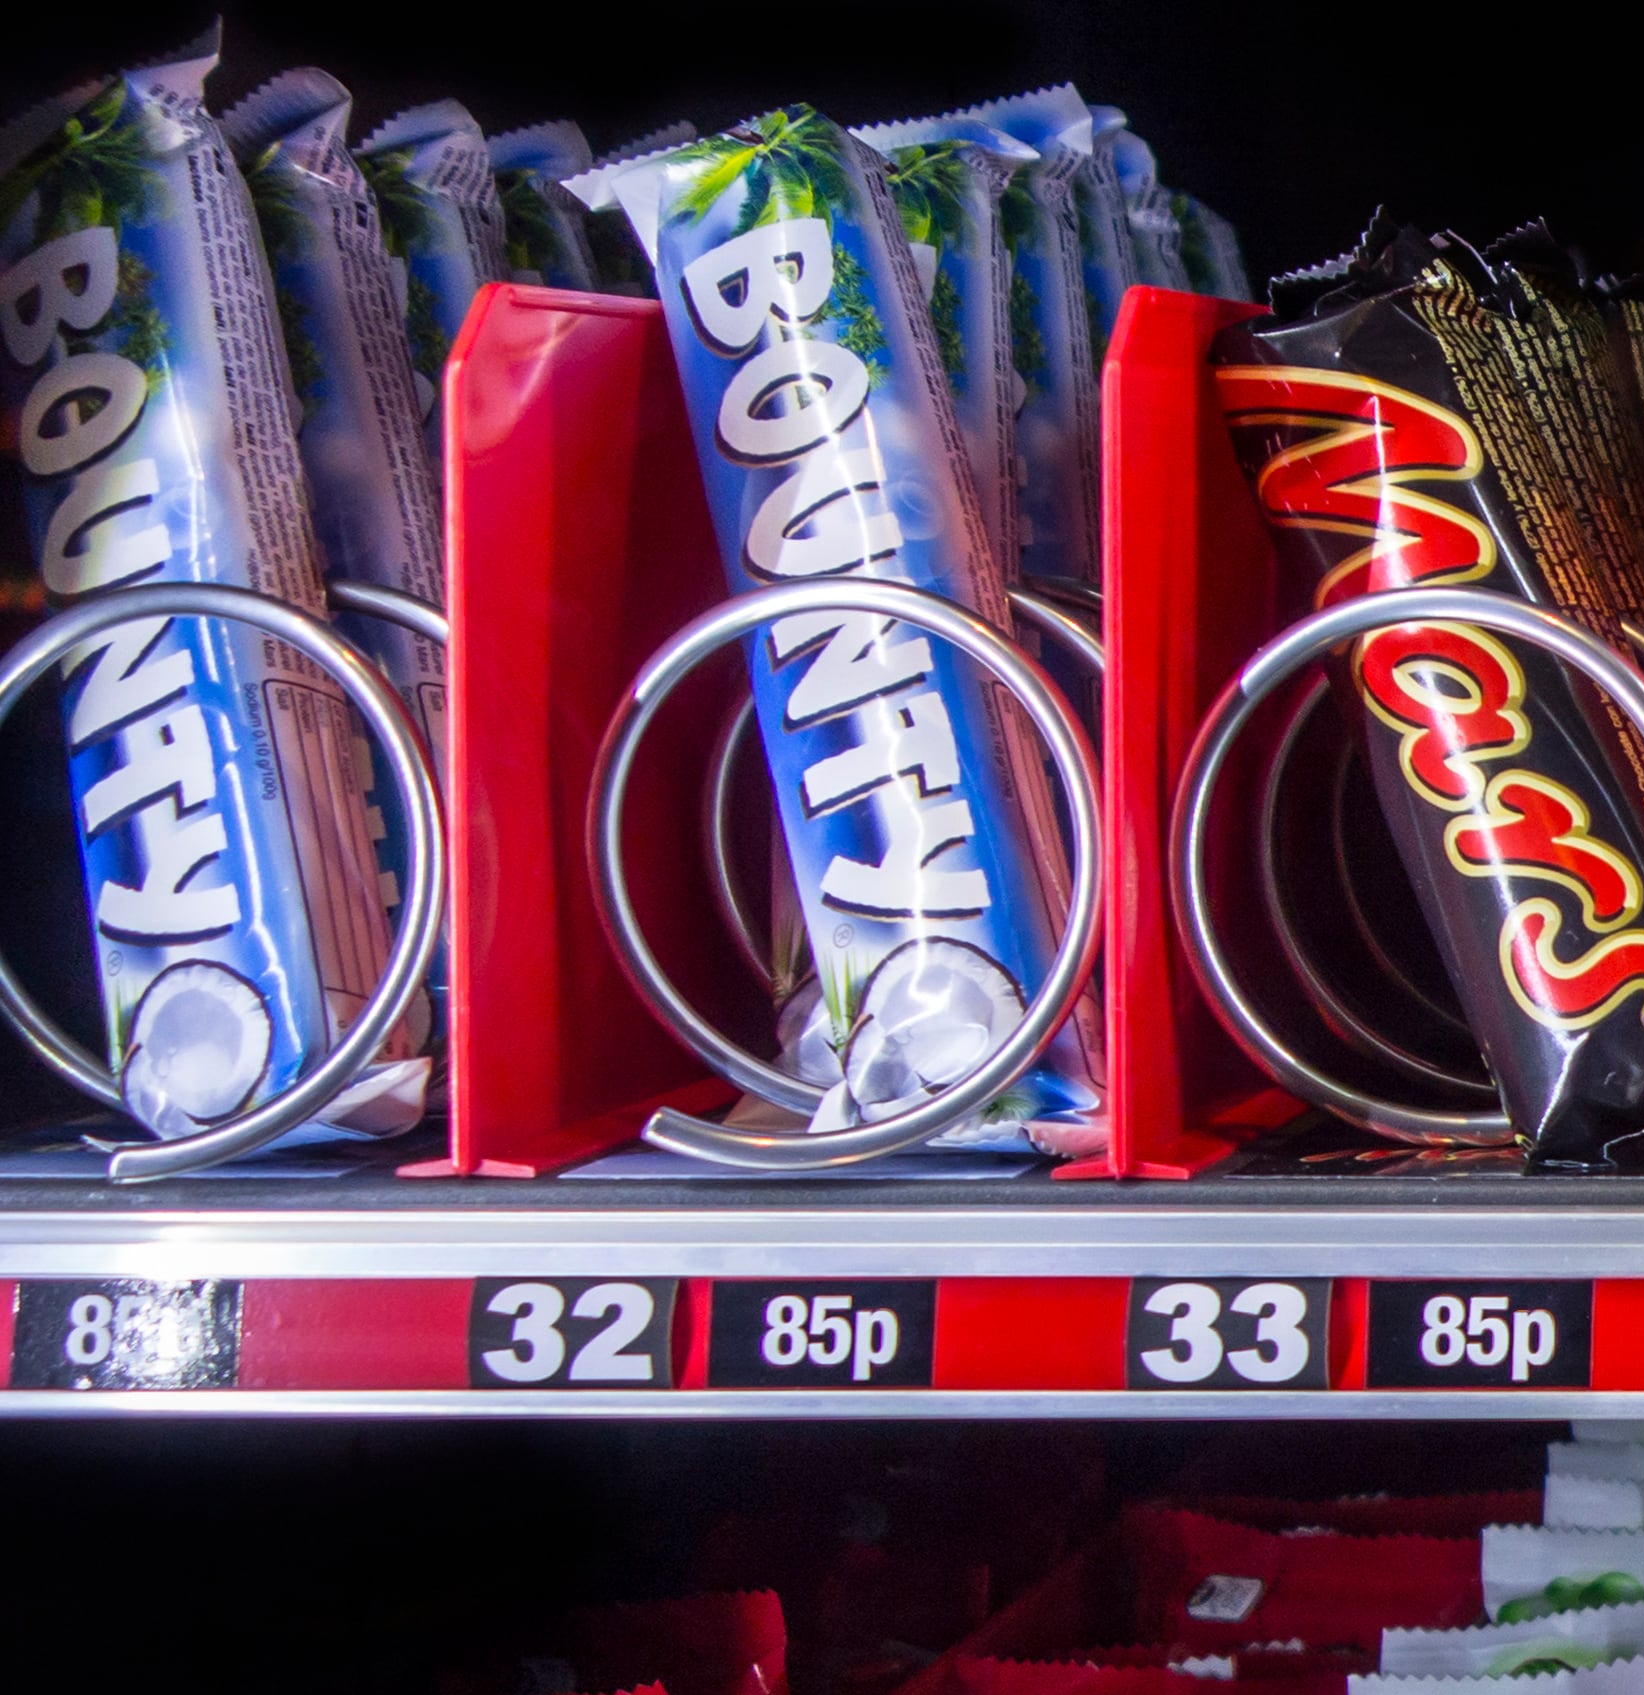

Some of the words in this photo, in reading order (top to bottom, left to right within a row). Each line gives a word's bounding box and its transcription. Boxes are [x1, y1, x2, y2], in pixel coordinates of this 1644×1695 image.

[2, 226, 242, 938] BOUNTY
[683, 217, 992, 912] BOUNTY
[242, 681, 265, 728] Sodium
[483, 1283, 653, 1381] 32
[764, 1296, 897, 1380] 85p
[1141, 1283, 1308, 1381] 33
[1422, 1297, 1554, 1380] 85p
